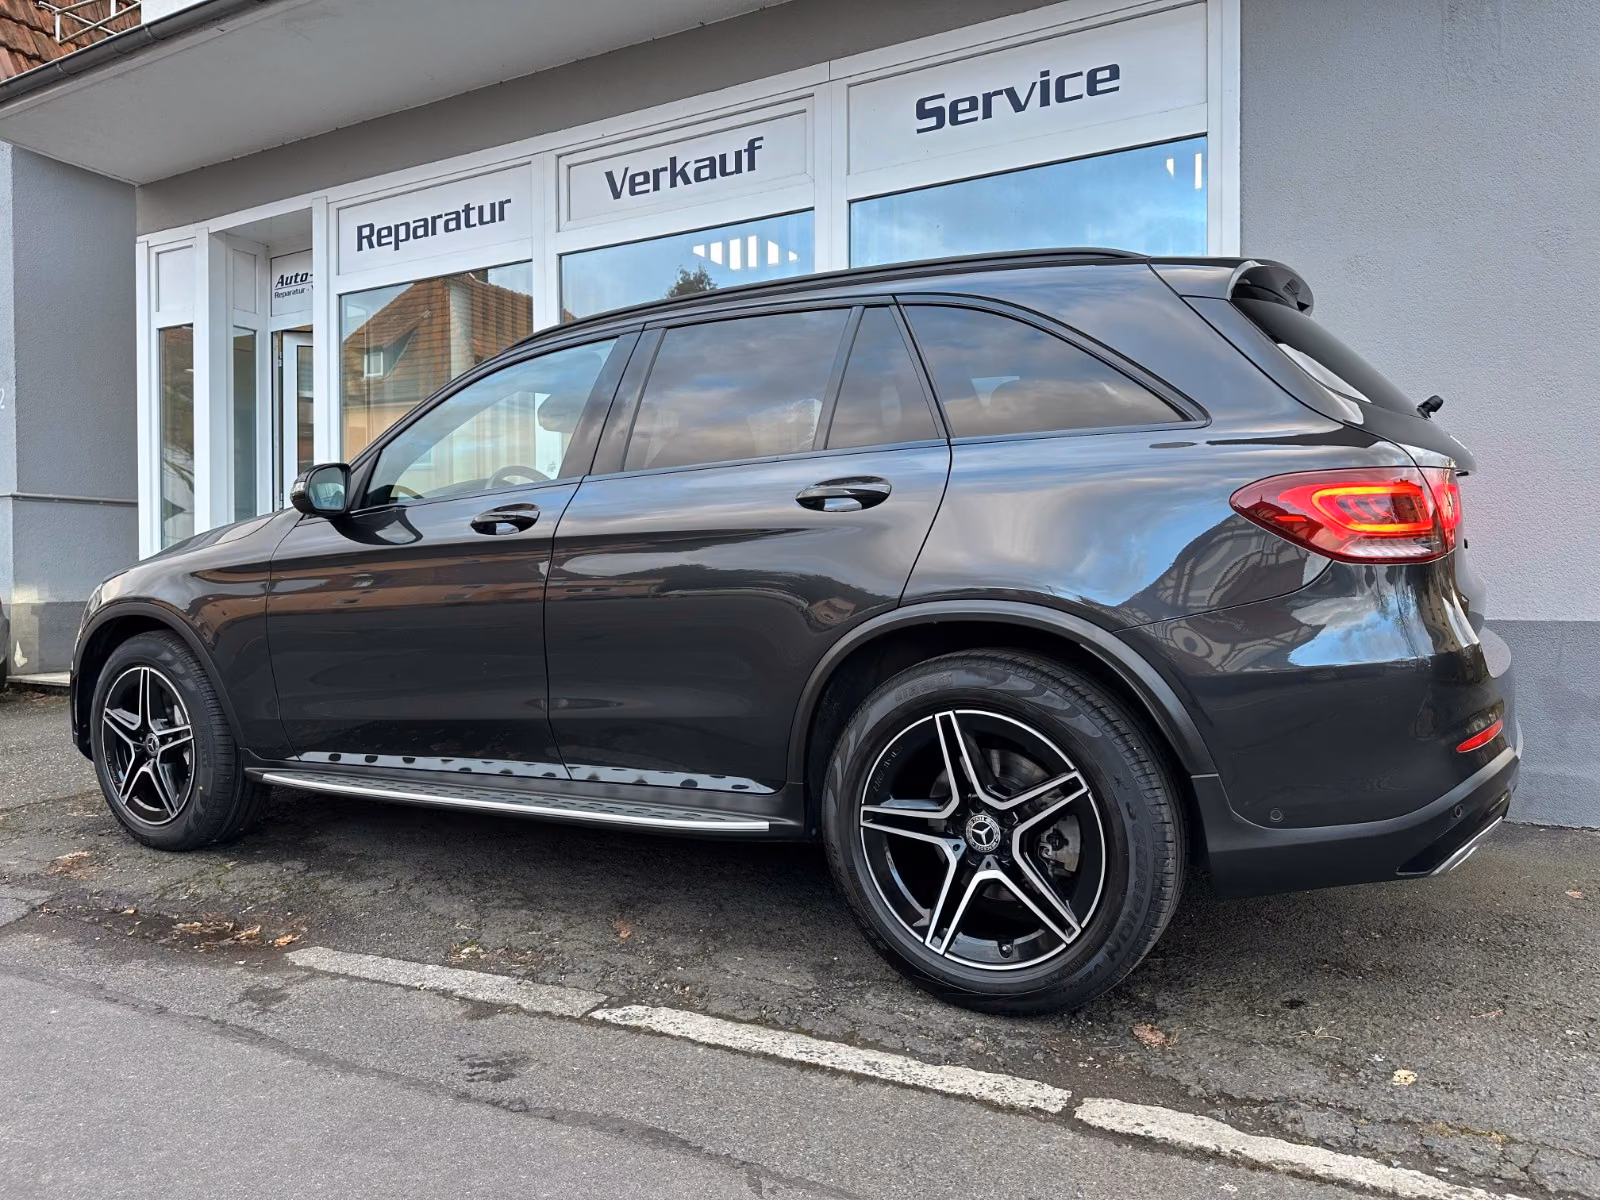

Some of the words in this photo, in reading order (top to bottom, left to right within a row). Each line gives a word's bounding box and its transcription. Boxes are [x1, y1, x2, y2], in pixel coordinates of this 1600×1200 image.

[916, 63, 1120, 134] Service
[604, 136, 764, 200] Verkauf
[356, 198, 512, 252] Reparatur
[274, 288, 306, 299] Reparatur
